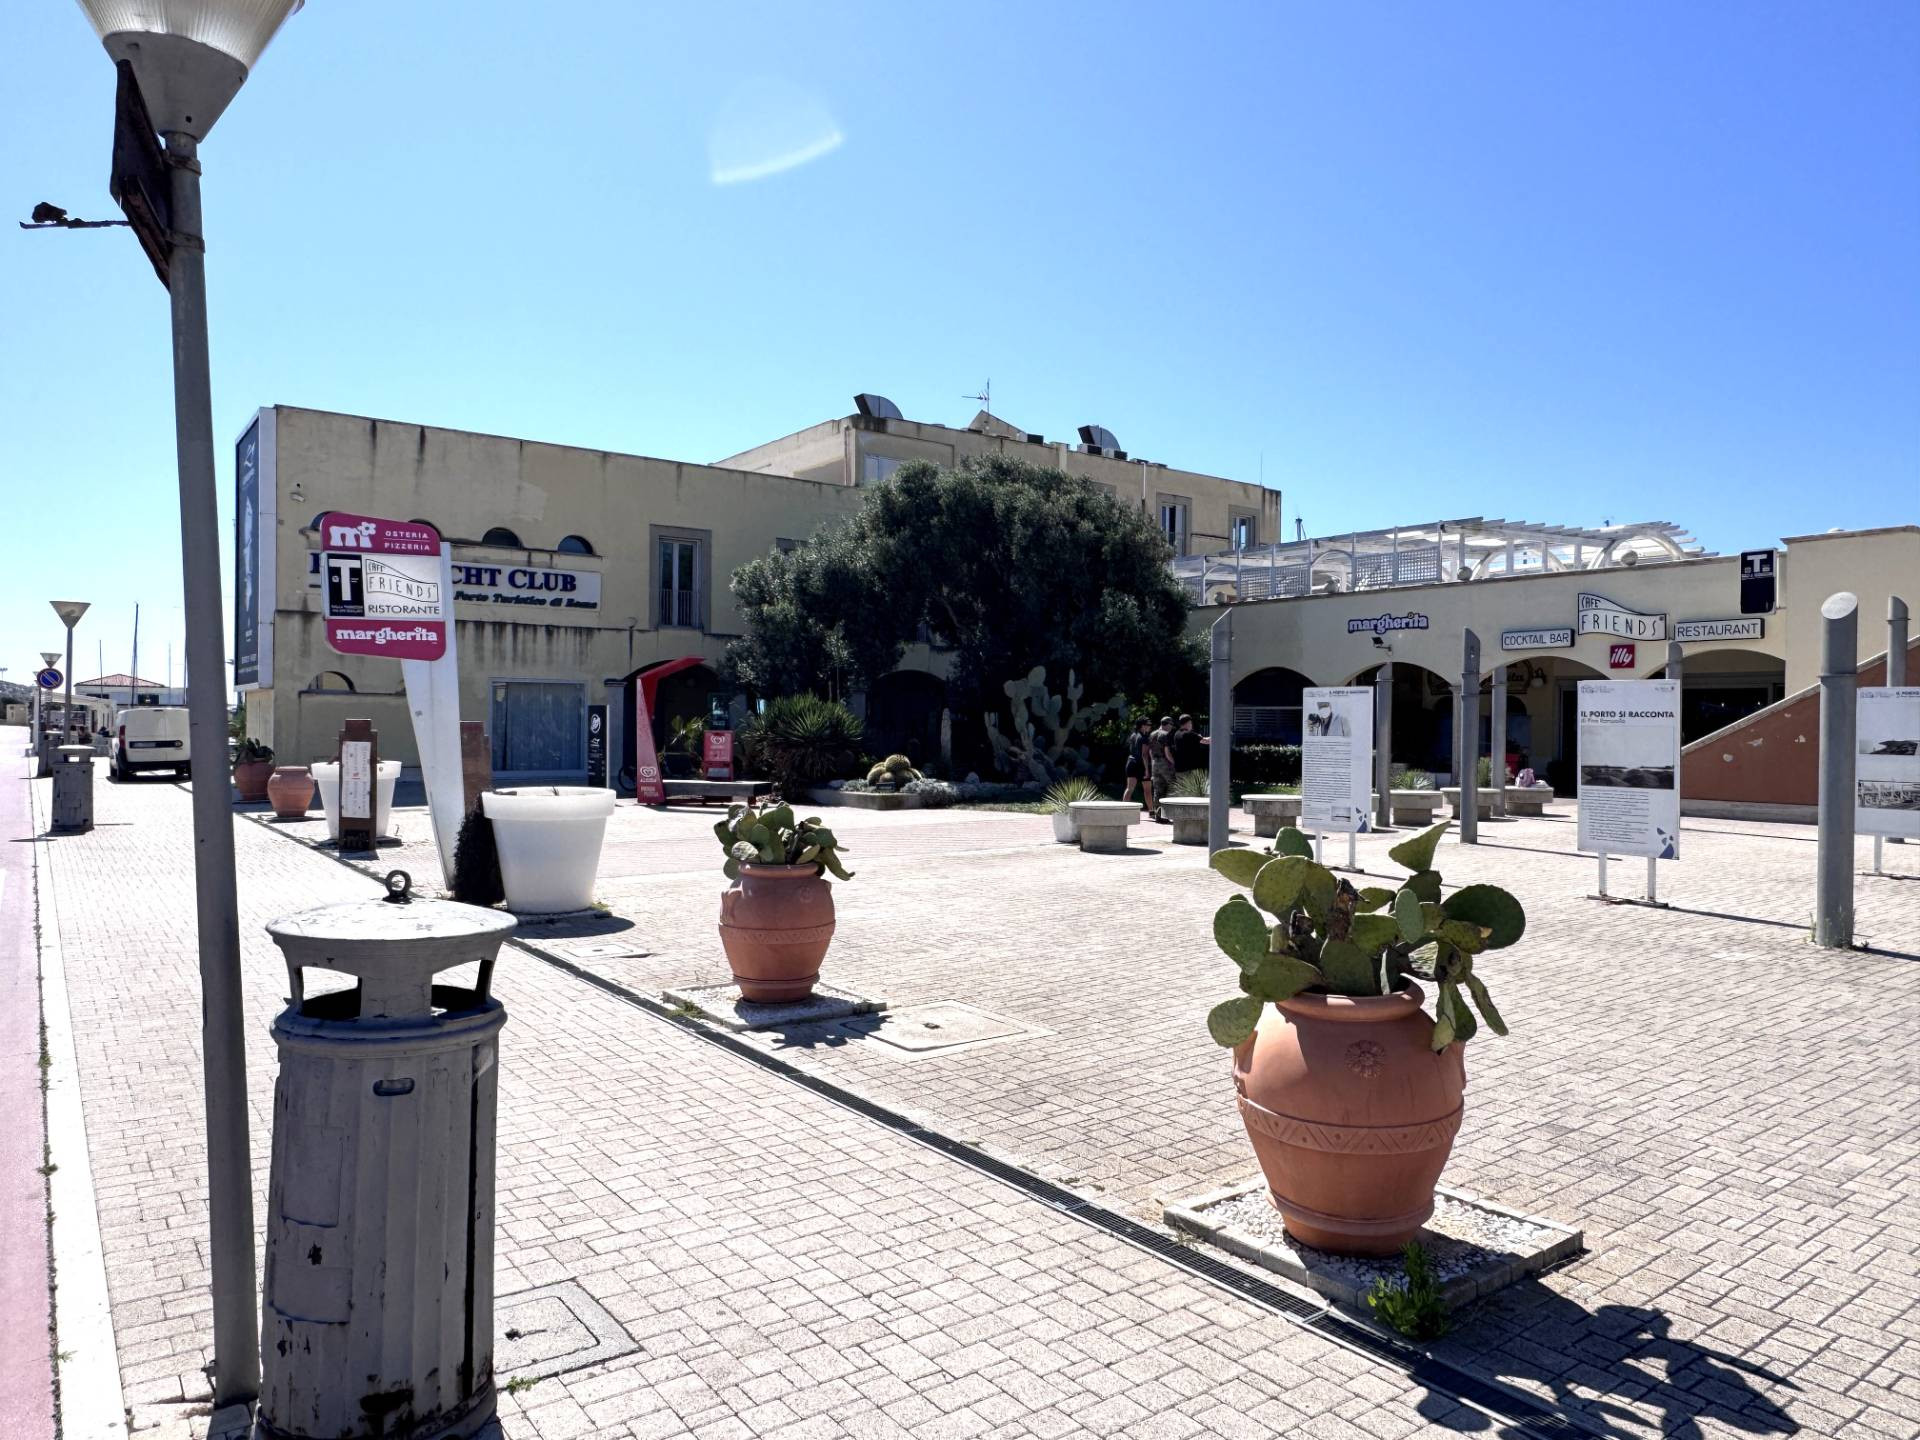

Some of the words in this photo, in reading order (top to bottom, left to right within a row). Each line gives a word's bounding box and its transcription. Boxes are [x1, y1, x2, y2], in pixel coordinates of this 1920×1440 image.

[385, 530, 430, 539] OSTERIA
[384, 542, 431, 551] PIZZERIA
[369, 577, 432, 599] FRIENDS
[508, 569, 577, 592] CLUB
[368, 604, 440, 615] RISTORANTE
[1348, 612, 1429, 634] margherita
[1581, 614, 1657, 636] FRIENDS
[1677, 623, 1760, 637] RESTAURANT
[336, 627, 438, 645] margherita
[1504, 634, 1547, 646] COCKTAIL
[1549, 633, 1570, 644] BAR
[1610, 648, 1633, 667] illy
